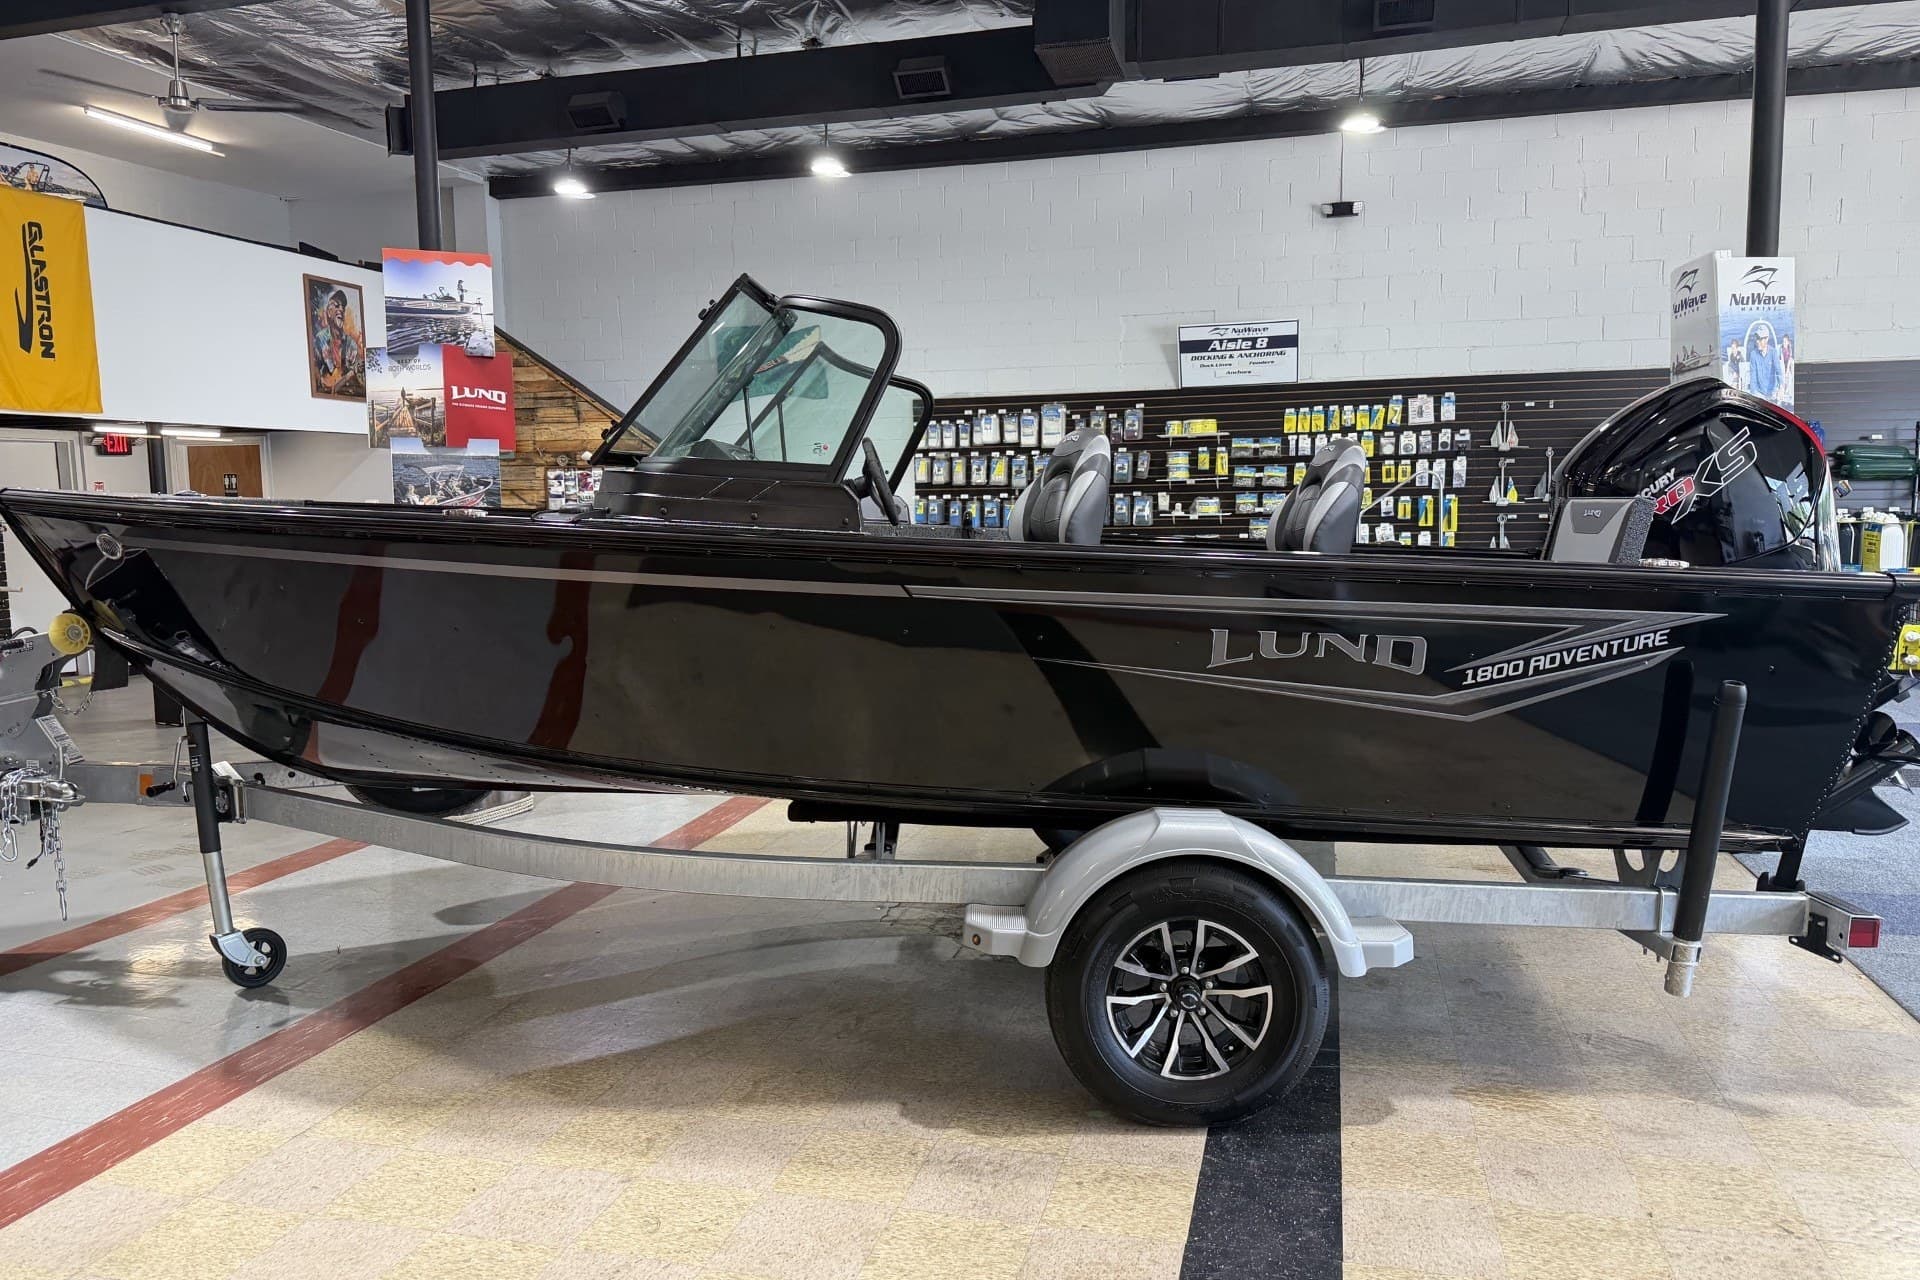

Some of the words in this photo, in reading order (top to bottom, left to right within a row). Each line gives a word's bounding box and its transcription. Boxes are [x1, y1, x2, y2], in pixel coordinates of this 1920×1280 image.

[27, 221, 55, 359] GLASTRON
[1729, 292, 1787, 307] NuWave
[1231, 326, 1269, 334] NuWave
[1208, 339, 1252, 351] Aisle
[1255, 337, 1269, 349] 8
[1190, 354, 1227, 362] DOCKING
[1228, 352, 1235, 360] &
[1237, 350, 1287, 359] ANCHORING
[451, 385, 507, 404] LUND
[106, 433, 128, 453] EXIT
[1635, 467, 1676, 498] CURY
[1206, 628, 1428, 675] LUND
[1462, 661, 1526, 686] 1800
[1527, 629, 1671, 678] ADVENTURE
